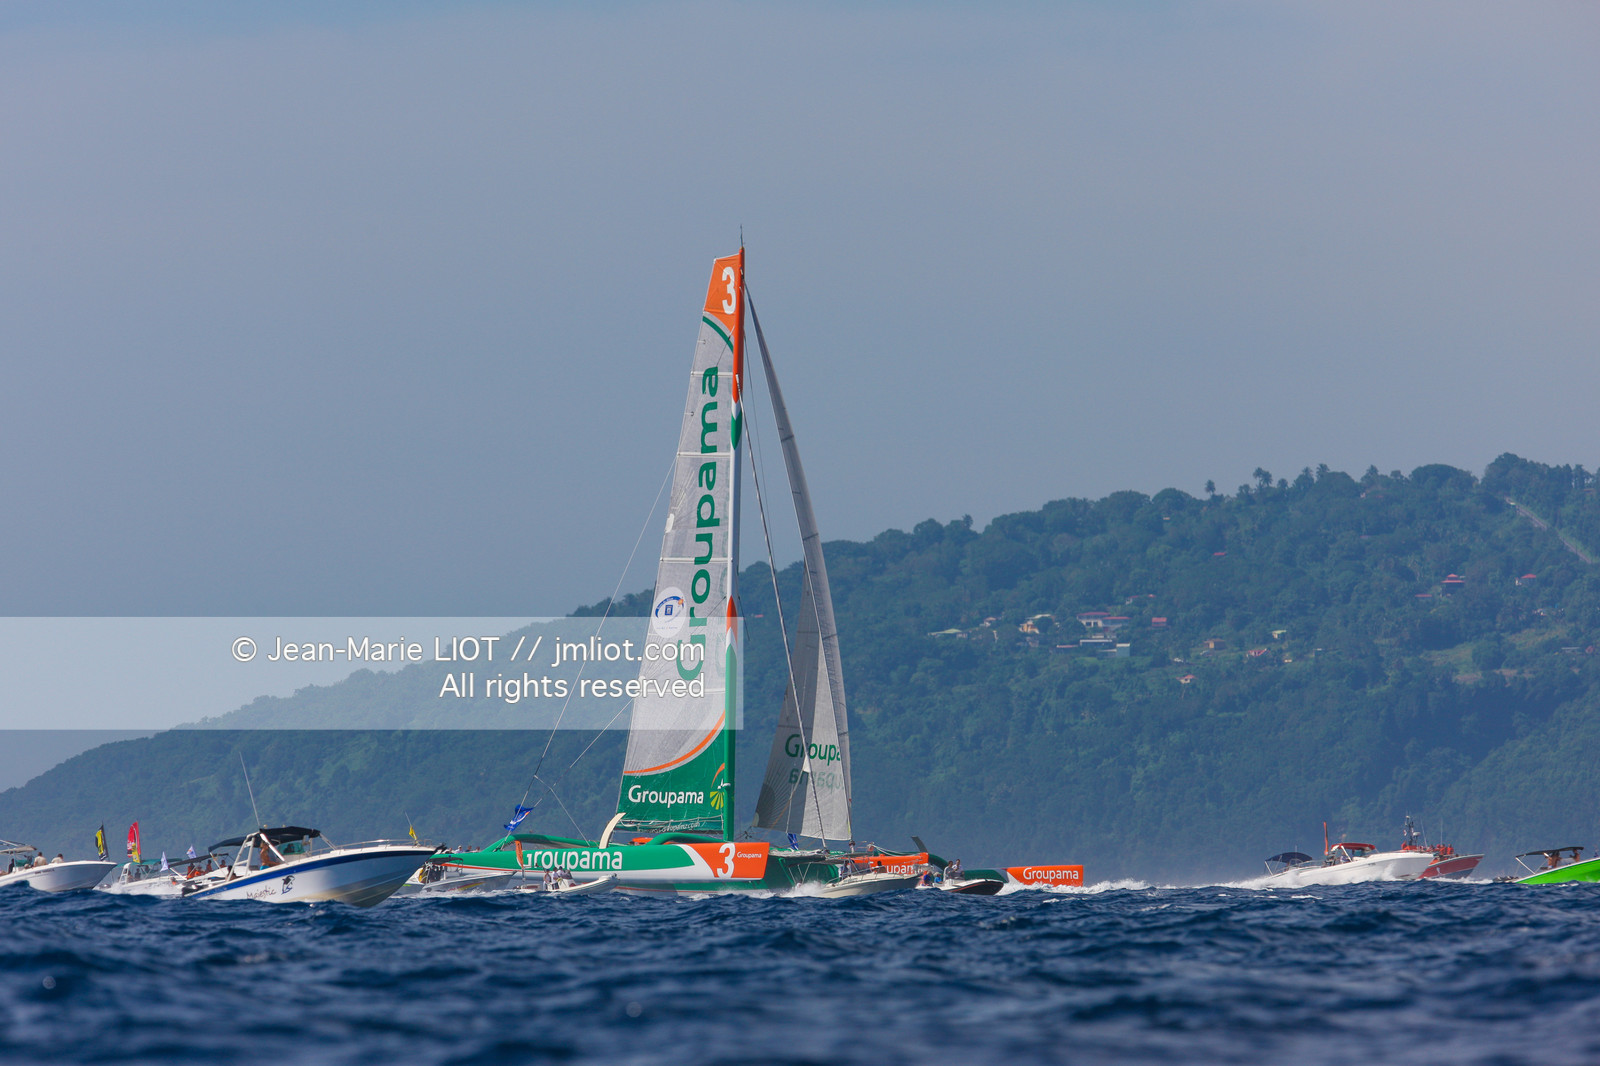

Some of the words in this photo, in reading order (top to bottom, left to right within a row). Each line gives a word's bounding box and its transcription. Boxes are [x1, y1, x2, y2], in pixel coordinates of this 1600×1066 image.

[722, 266, 736, 315] 3
[676, 366, 720, 681] Groupama
[628, 785, 704, 808] Groupama
[717, 843, 736, 878] 3
[736, 851, 762, 859] Groupama
[1023, 867, 1079, 882] Groupama
